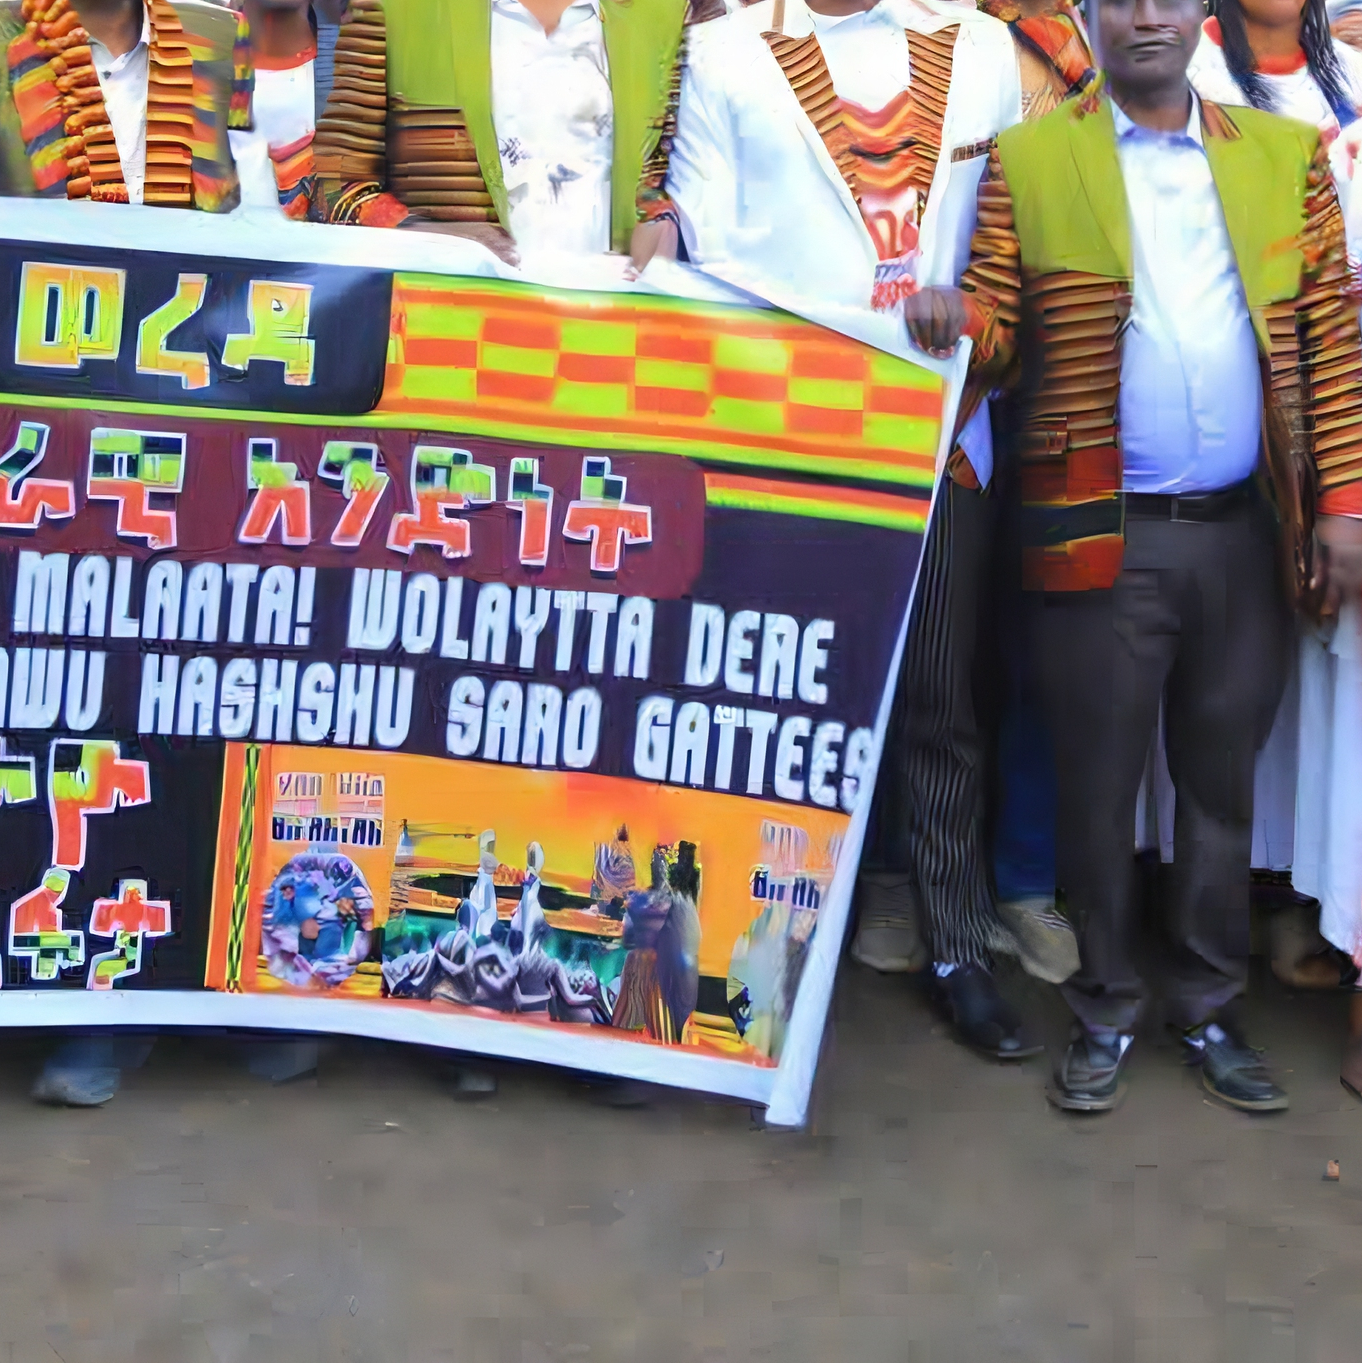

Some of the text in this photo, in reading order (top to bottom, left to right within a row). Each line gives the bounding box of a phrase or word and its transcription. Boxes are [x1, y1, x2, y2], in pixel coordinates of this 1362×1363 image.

[15, 262, 315, 389] ወረዳ
[238, 438, 652, 573] አንድነት
[347, 566, 655, 680] WOLAYTTA
[137, 652, 416, 749] HASHSHU
